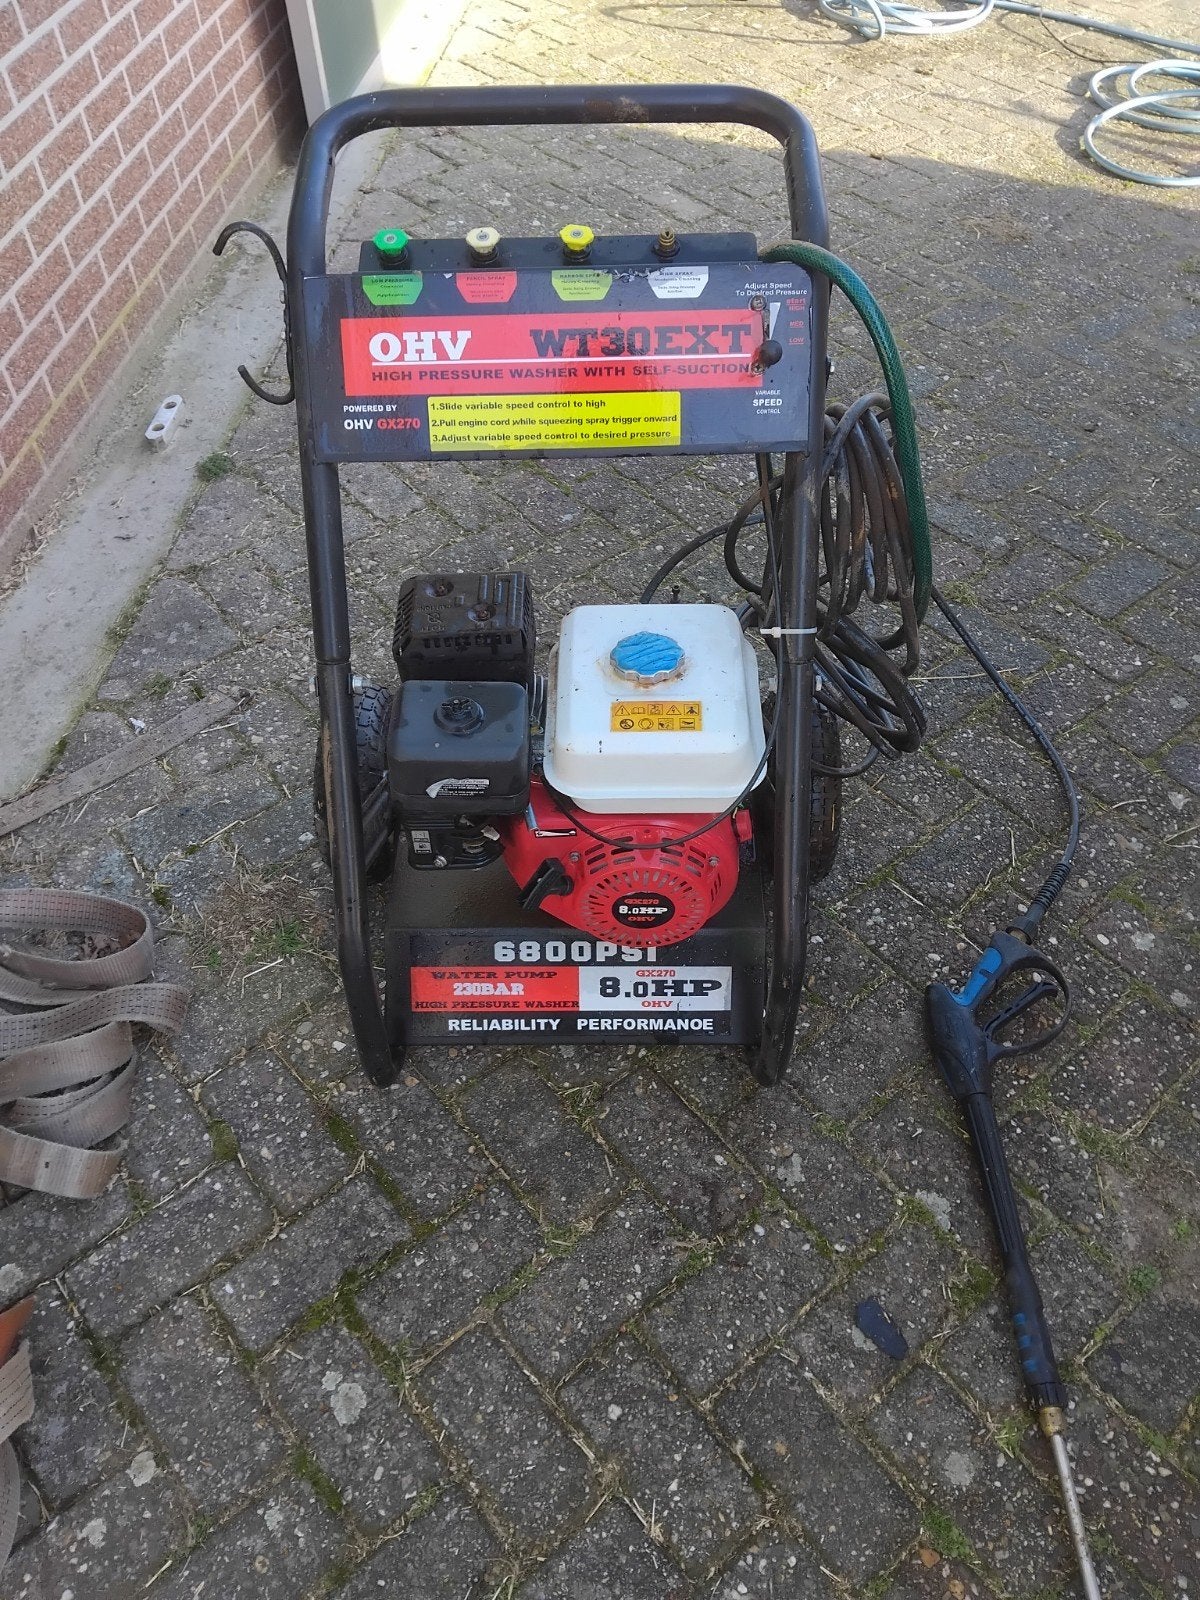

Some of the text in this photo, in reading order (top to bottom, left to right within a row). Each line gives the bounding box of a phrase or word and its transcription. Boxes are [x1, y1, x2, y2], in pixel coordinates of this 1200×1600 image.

[744, 282, 792, 292] Adjust Speed
[775, 288, 808, 296] Pressure
[368, 323, 752, 362] OHV WT30EXT
[371, 362, 750, 382] HIGH PRESSURE WASHER WITH SELF-SUCTION
[343, 404, 397, 413] POWERED BY
[431, 399, 607, 411] 1.Slide variable speed control to high
[752, 398, 783, 407] SPEED
[343, 417, 421, 430] OHV GX270
[431, 413, 678, 428] 2.Pull engine cord while squeezing spray trigger onward
[432, 429, 672, 444] 3.Adjust variable speed control to desired pressure
[618, 905, 668, 915] 8.0HP
[494, 940, 657, 962] 6800PSI
[431, 971, 557, 979] WATER PUMP
[636, 969, 676, 978] GX270
[453, 982, 525, 996] 230BAR
[600, 976, 723, 998] 8.0HP
[415, 1000, 580, 1009] HIGH PRESSURE WASHER
[641, 1000, 674, 1008] OHV
[448, 1018, 561, 1031] RELIABILITY
